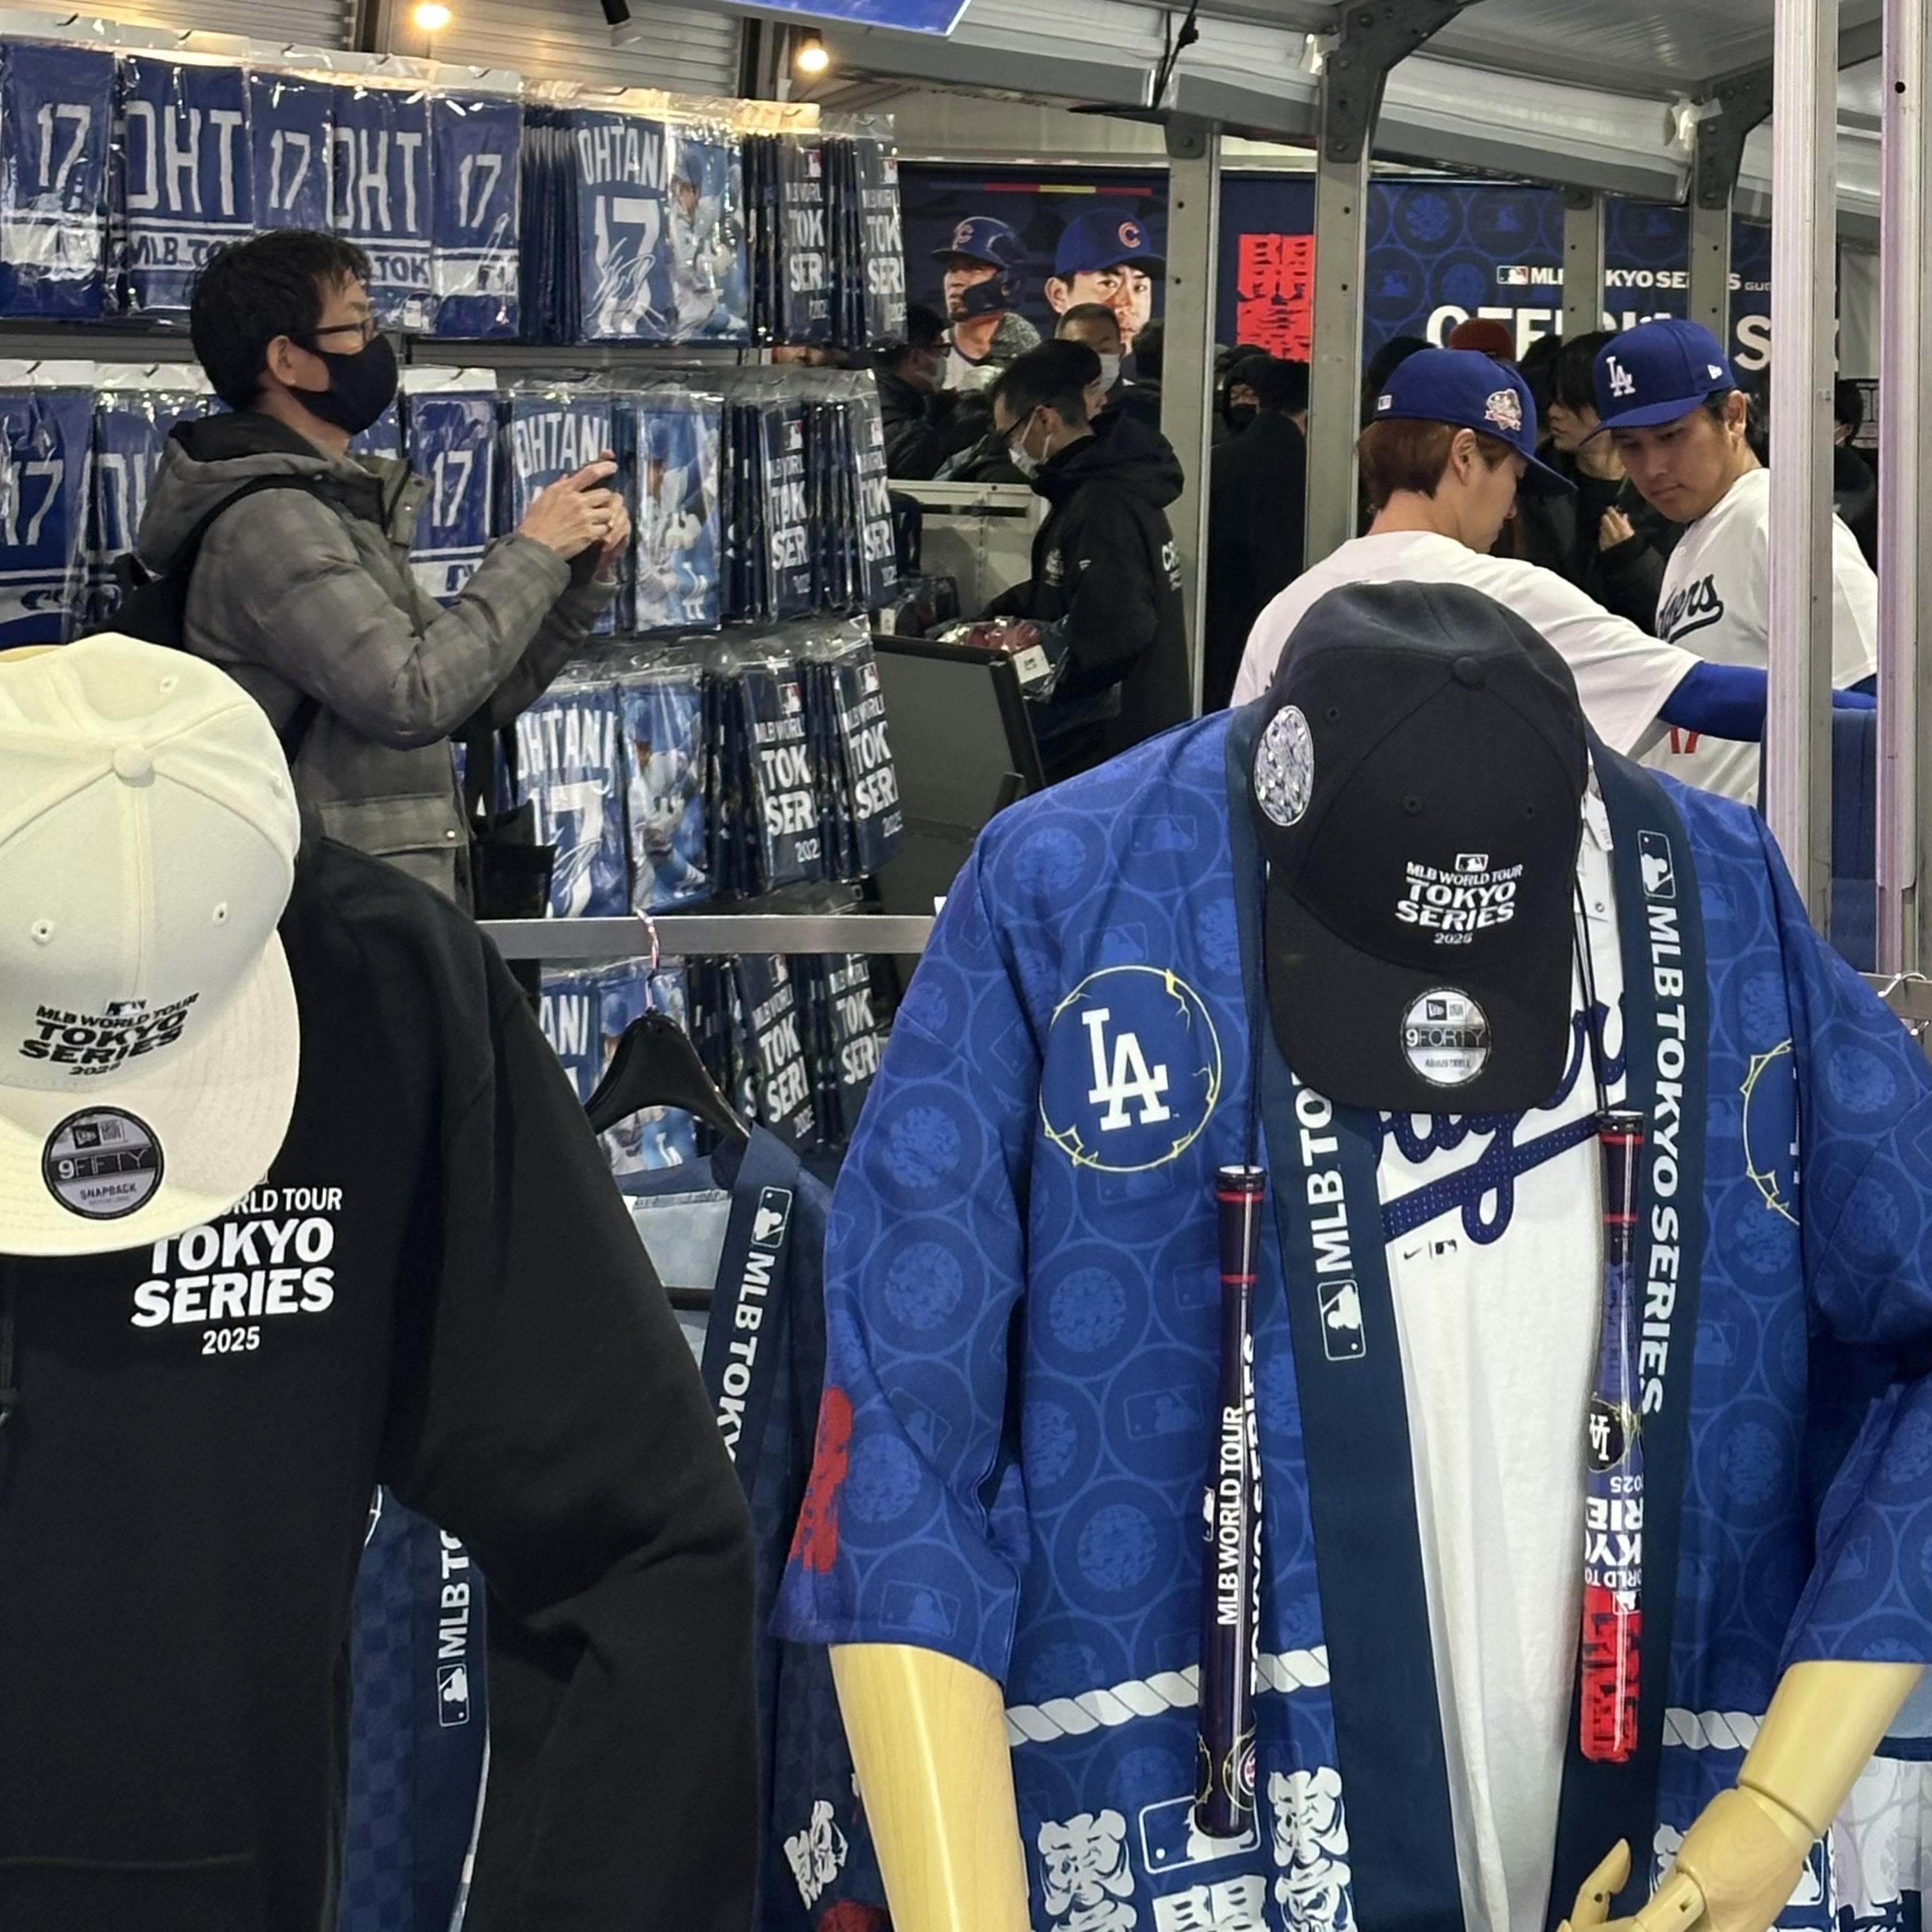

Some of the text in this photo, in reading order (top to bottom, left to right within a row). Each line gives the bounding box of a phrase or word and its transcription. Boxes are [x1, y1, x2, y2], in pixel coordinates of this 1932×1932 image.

[38, 103, 91, 192] 17
[270, 129, 311, 209] 17
[459, 154, 502, 228] 17
[1118, 221, 1141, 248] C
[595, 195, 661, 335] 17
[790, 251, 827, 292] SER
[1605, 270, 1654, 288] KYO
[1656, 271, 1741, 290] SES
[1606, 356, 1636, 397] LA
[431, 449, 473, 527] 17
[772, 525, 810, 570] SER
[761, 744, 812, 790] TOK
[849, 720, 892, 775] TOK
[1405, 875, 1517, 909] TOKYO
[1406, 861, 1524, 886] MLB WORLD TOUR
[1395, 900, 1515, 932] SERIES
[36, 992, 200, 1029] MLB WORLD TOUR
[36, 1009, 189, 1047] TOKYO
[836, 987, 875, 1039] TOK
[18, 1024, 184, 1064] SERIES
[759, 1011, 801, 1076] TOK
[1081, 1007, 1171, 1132] LA
[1291, 1071, 1353, 1274] MLB TO
[1638, 905, 1686, 1415] MLB TOKYO SERIES
[225, 1187, 343, 1215] RLD TOUR
[151, 1217, 334, 1275] TOKYO
[131, 1267, 334, 1327] SERIES
[735, 1251, 776, 1331] MLB
[202, 1326, 261, 1355] 2025
[1217, 1405, 1244, 1626] MLB WORLD TOUR
[1586, 1496, 1643, 1531] RIE
[438, 1582, 470, 1660] MLB
